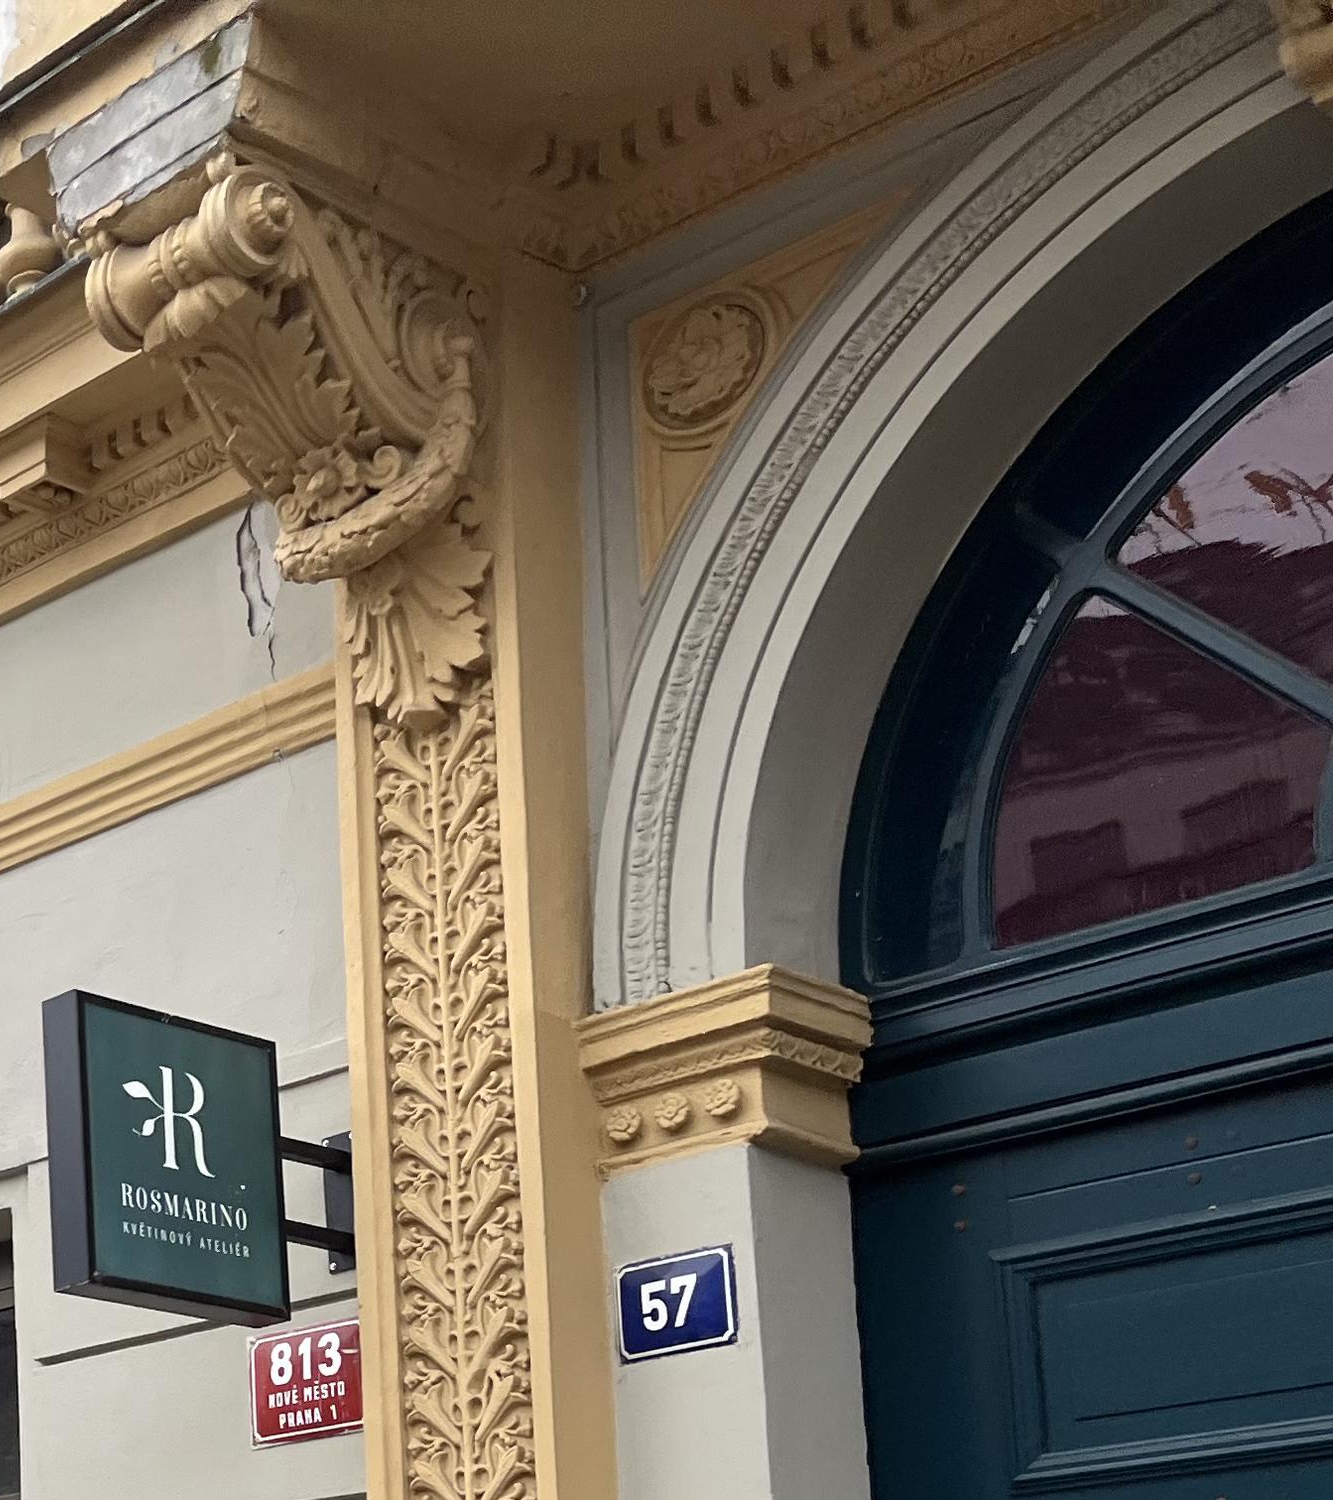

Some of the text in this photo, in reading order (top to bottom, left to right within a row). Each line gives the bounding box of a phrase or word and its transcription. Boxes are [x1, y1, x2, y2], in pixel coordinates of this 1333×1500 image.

[121, 1182, 248, 1231] ROSMARINO
[122, 1221, 251, 1258] KVĚTINOVÝ ATELIÉR
[640, 1272, 697, 1332] 57
[270, 1332, 342, 1386] 813
[268, 1380, 346, 1409] NOVÉ MĚSTO
[278, 1404, 338, 1429] PRAHA 1
